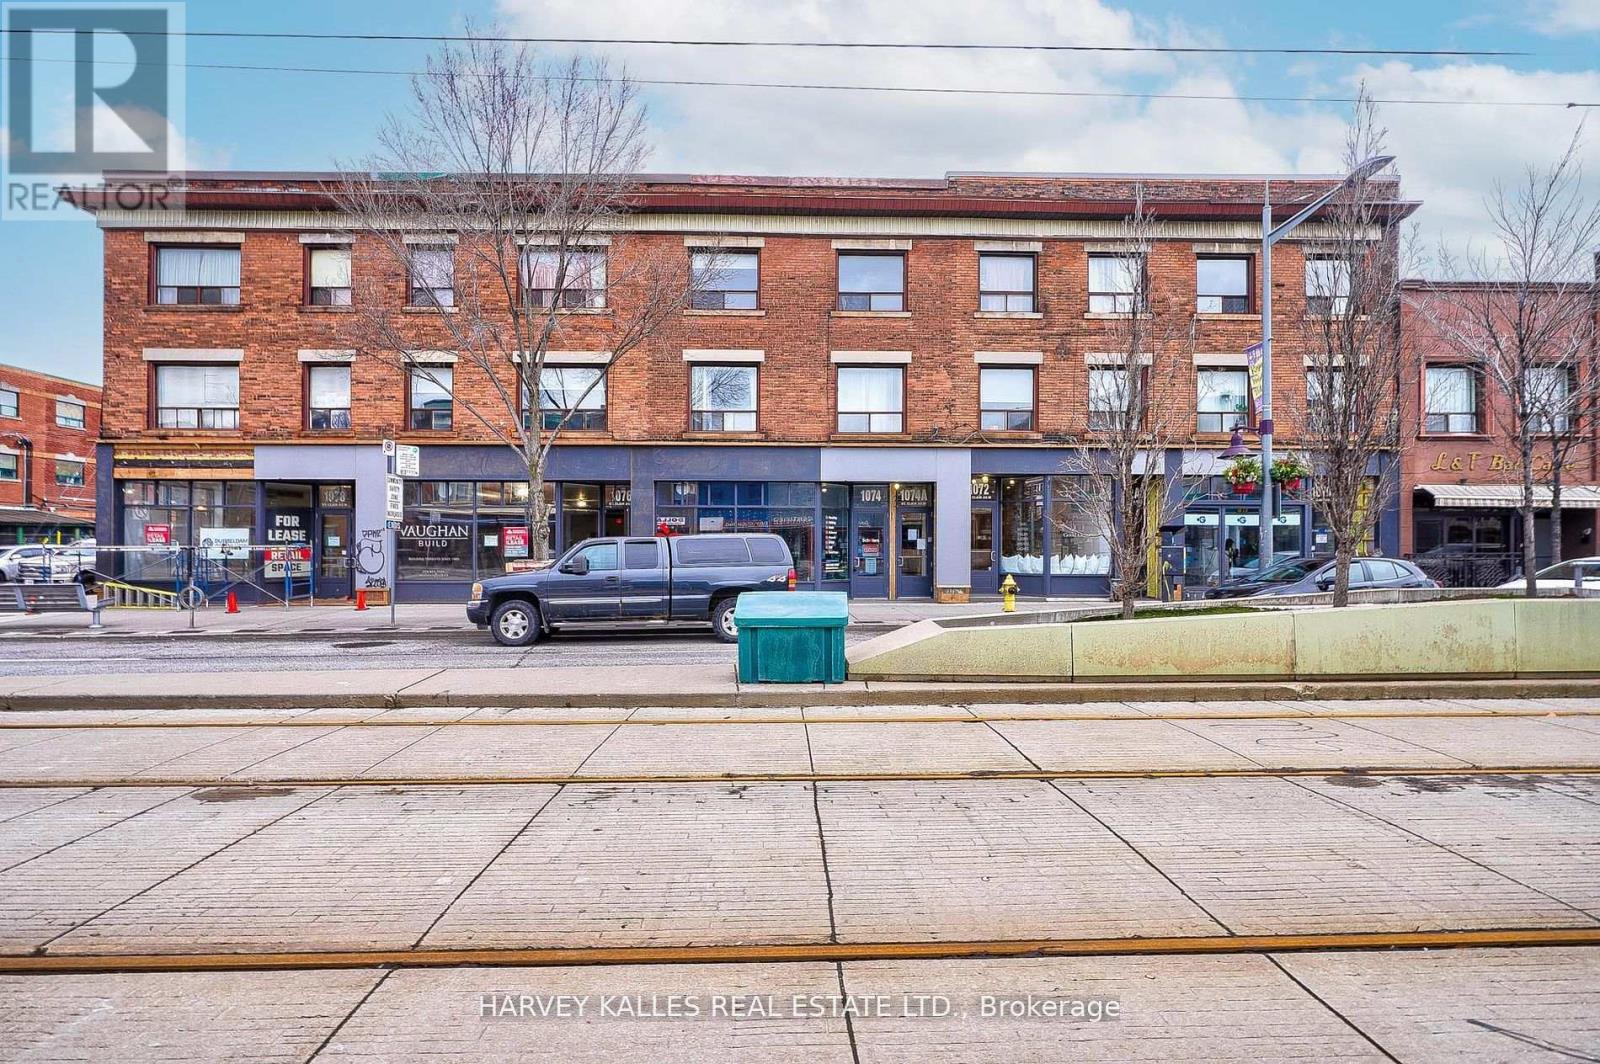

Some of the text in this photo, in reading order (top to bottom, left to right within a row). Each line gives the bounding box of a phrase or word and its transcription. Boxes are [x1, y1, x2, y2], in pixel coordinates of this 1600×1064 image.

[860, 490, 881, 502] 1074
[900, 489, 928, 501] 1074A
[276, 515, 300, 527] FOR
[268, 529, 306, 541] LEASE
[400, 525, 468, 536] VAUGHAN
